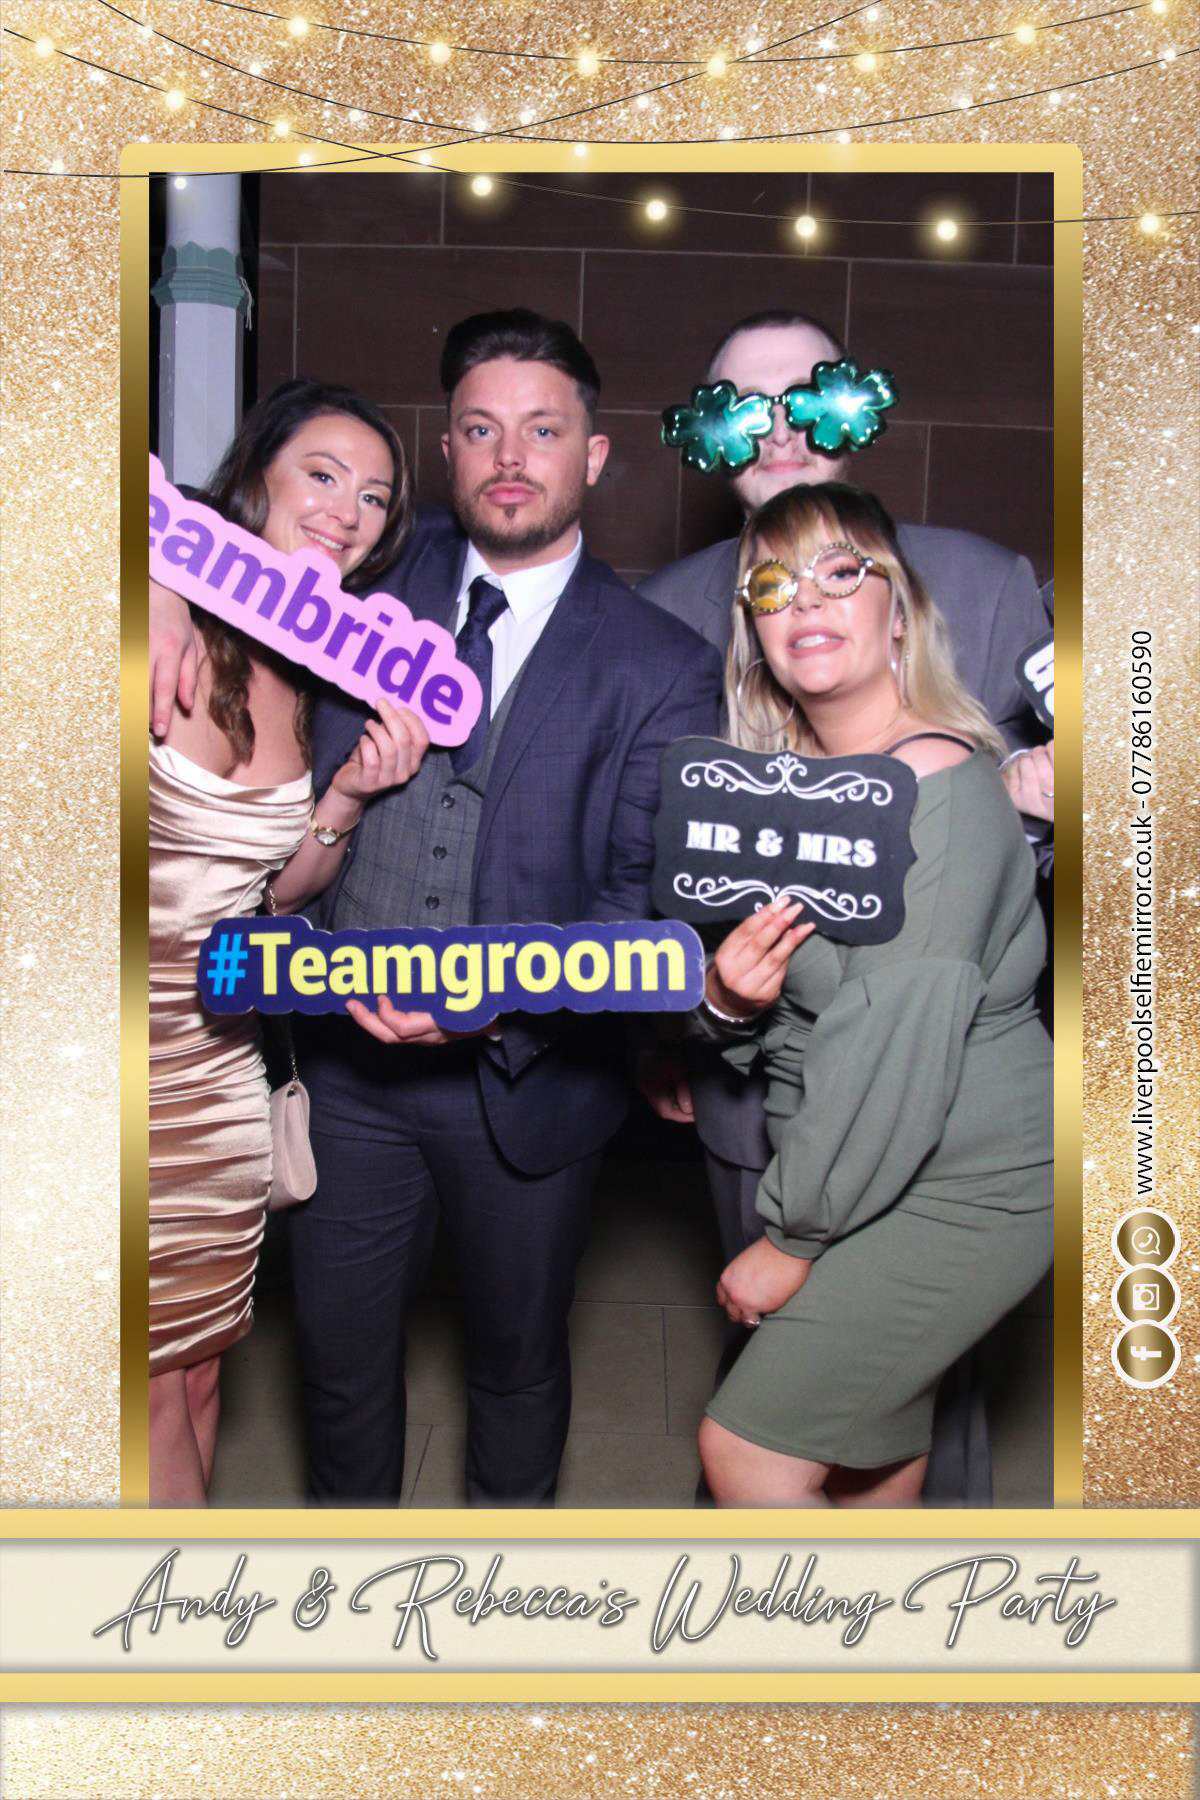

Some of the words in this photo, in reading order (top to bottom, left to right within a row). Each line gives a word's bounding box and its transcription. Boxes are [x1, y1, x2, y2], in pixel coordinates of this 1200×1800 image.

[686, 820, 741, 854] MR
[755, 828, 784, 858] &
[796, 832, 878, 868] MRS
[206, 931, 687, 1012] #Teamgroom
